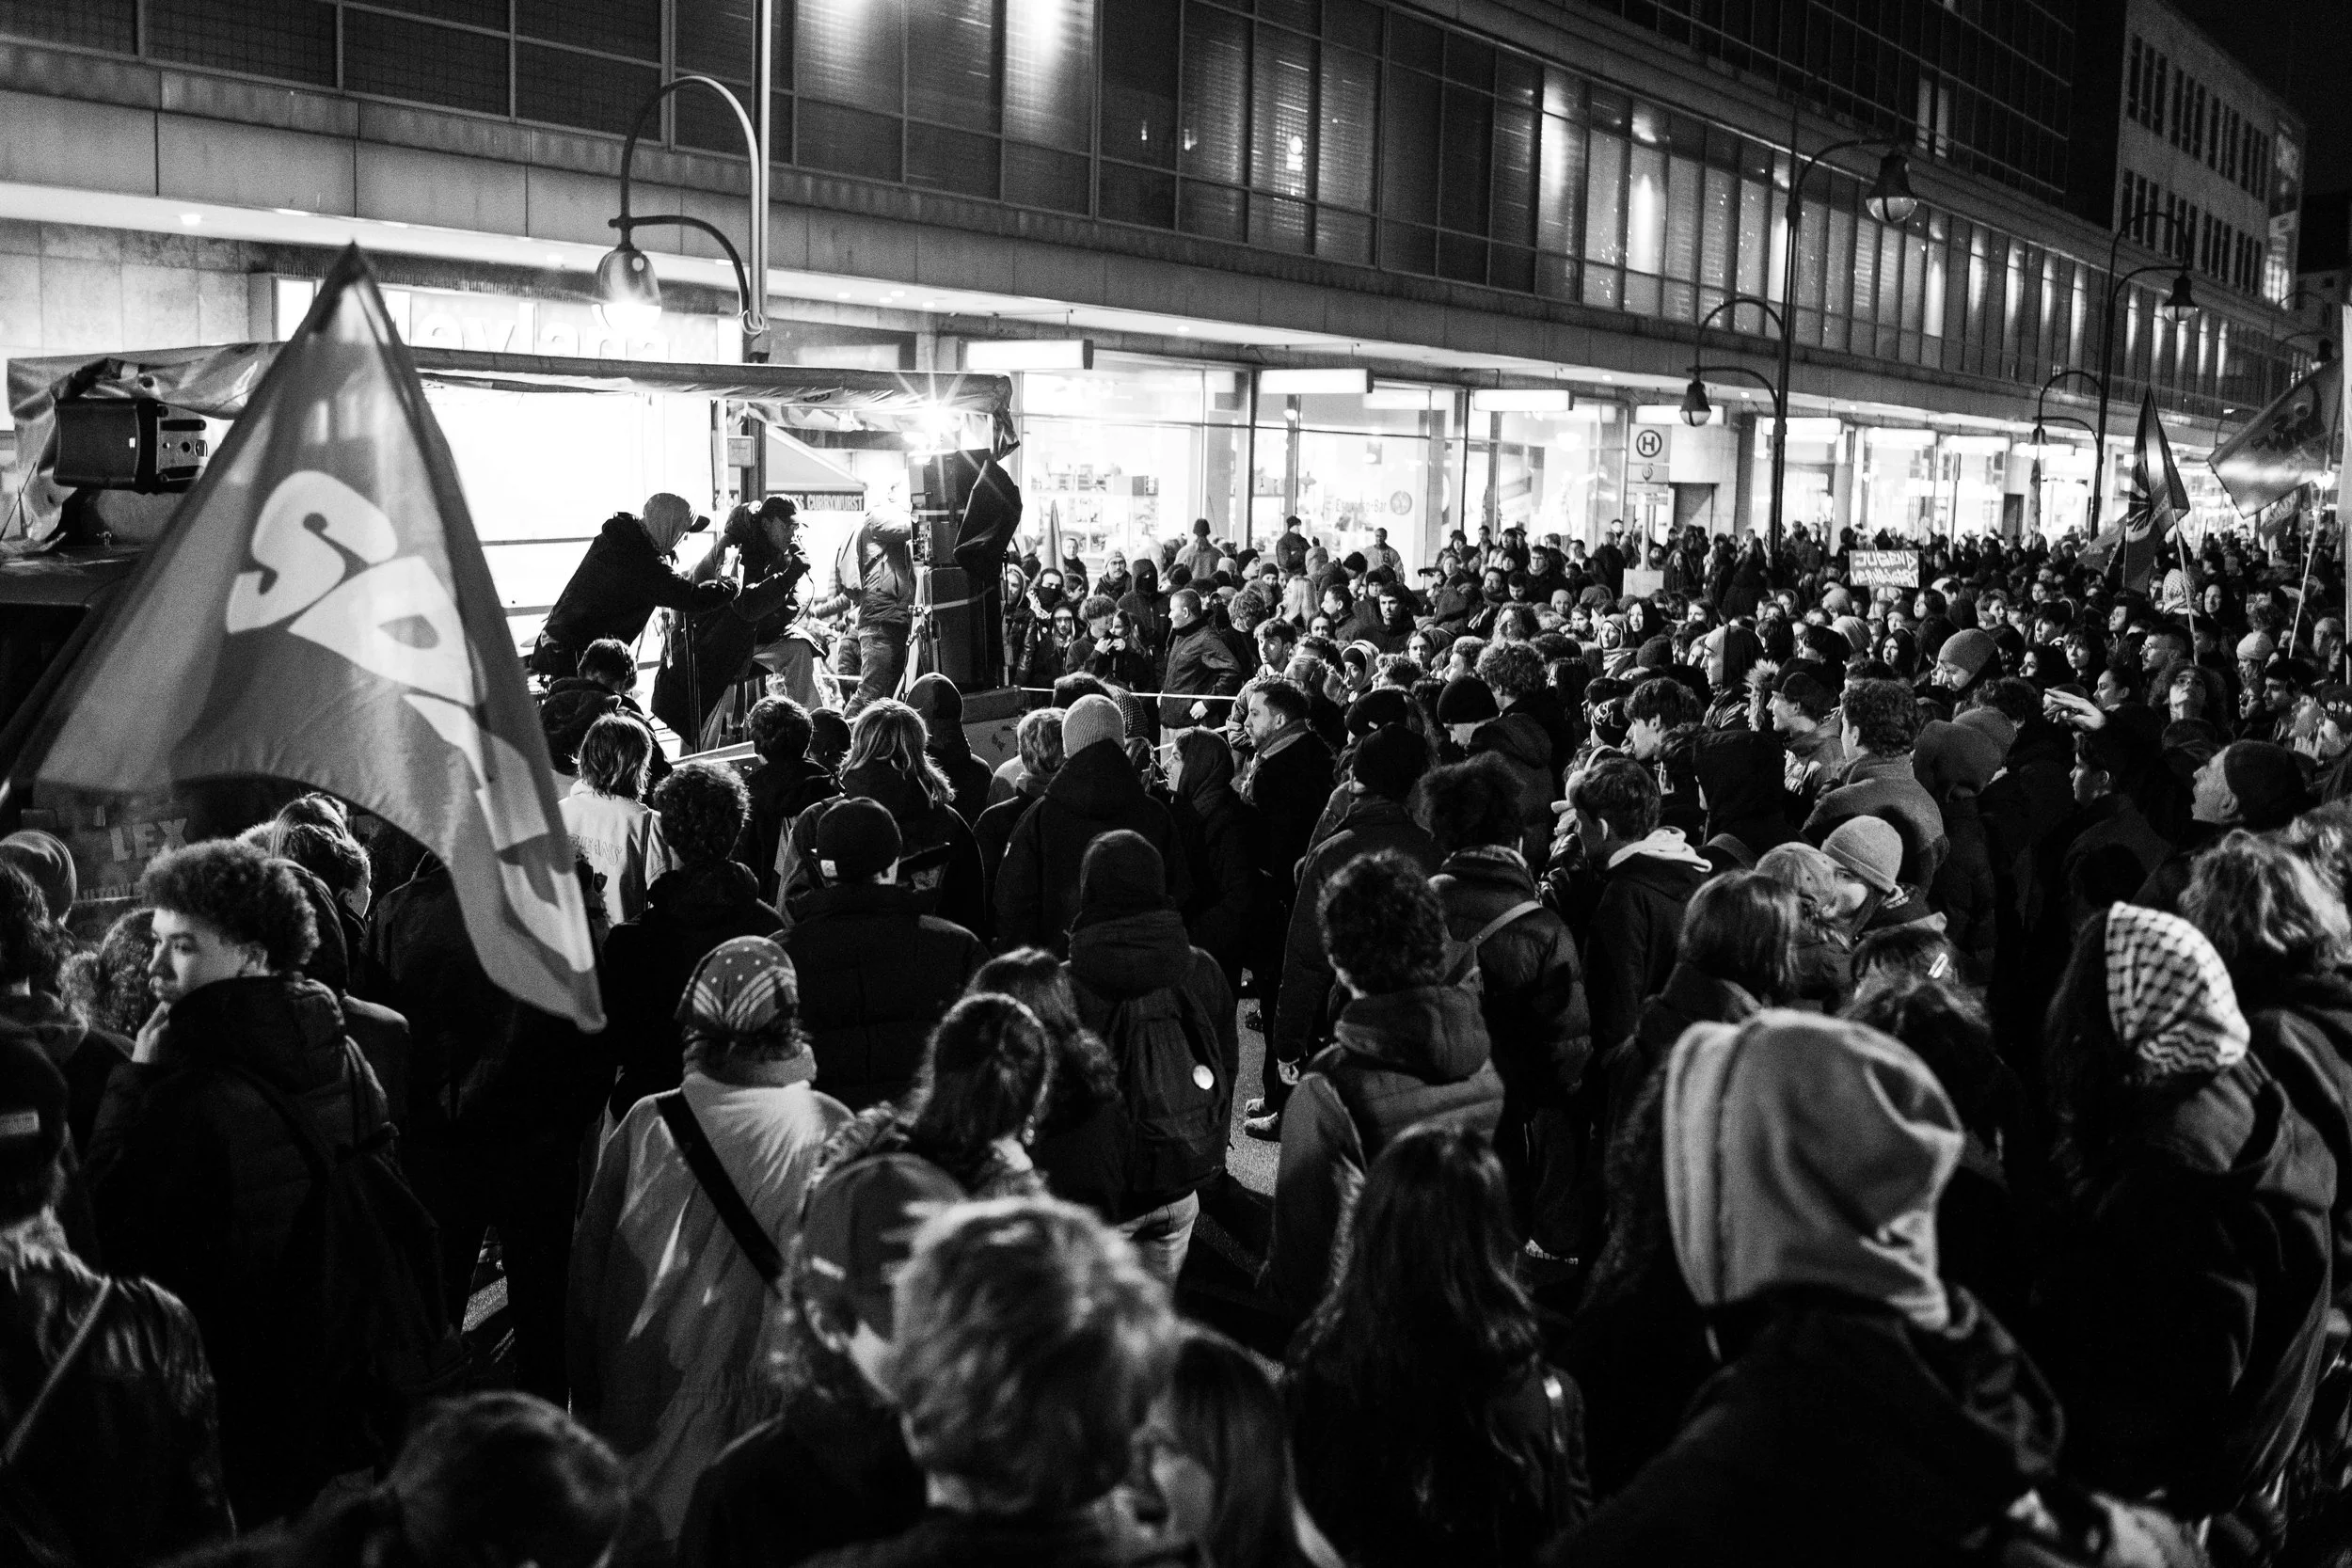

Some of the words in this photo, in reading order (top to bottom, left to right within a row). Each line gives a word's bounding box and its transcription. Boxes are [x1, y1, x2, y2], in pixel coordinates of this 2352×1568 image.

[1643, 436, 1656, 452] H
[806, 494, 864, 512] CURRYWURST
[1854, 550, 1917, 570] JUGEND
